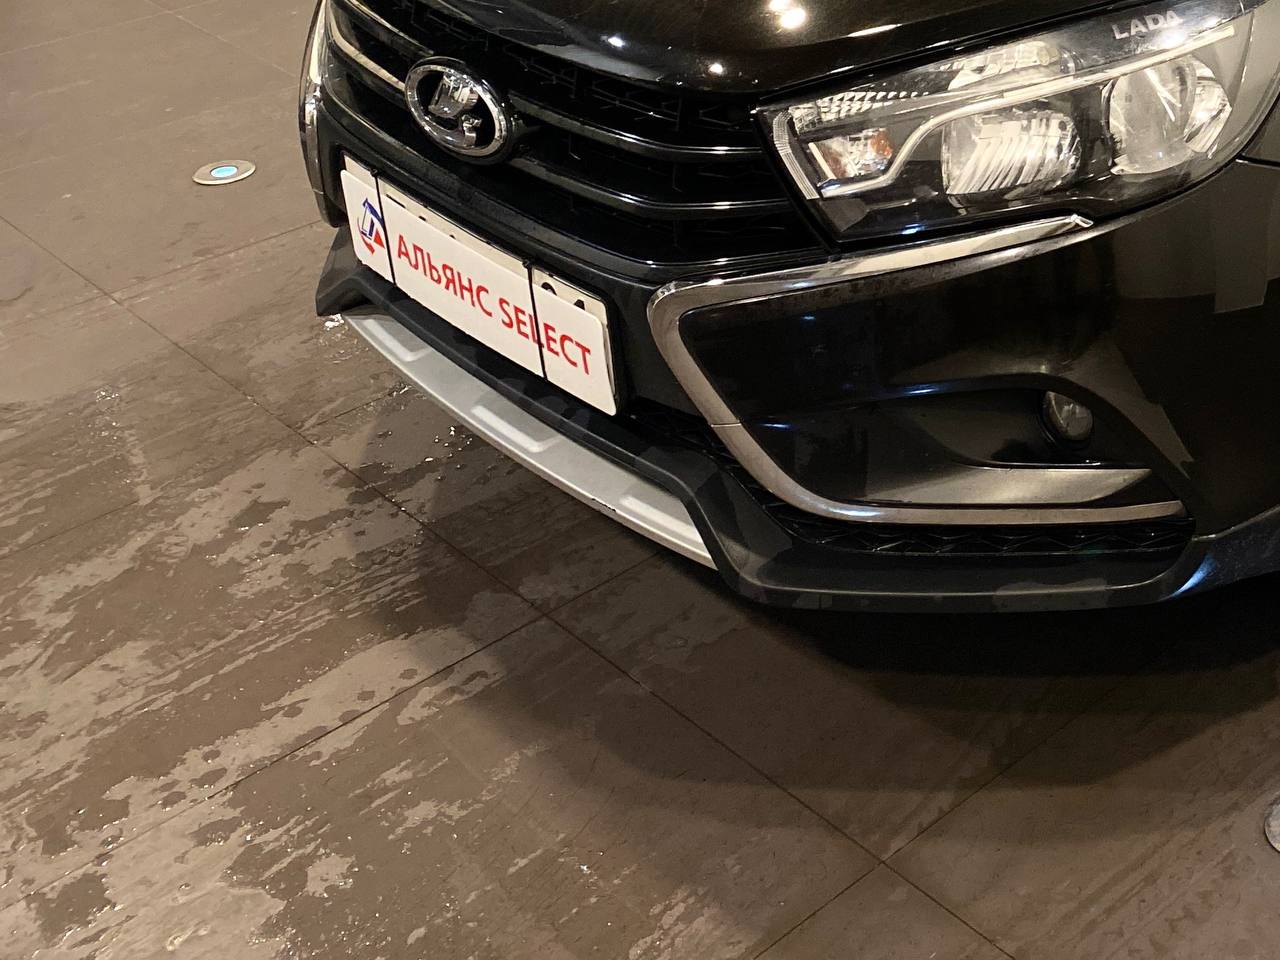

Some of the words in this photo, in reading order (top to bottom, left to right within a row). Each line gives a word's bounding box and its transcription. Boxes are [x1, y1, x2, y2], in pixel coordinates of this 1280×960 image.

[1111, 10, 1183, 40] LADA
[398, 234, 492, 317] АЛЬЯНС
[499, 297, 591, 375] SELECT
